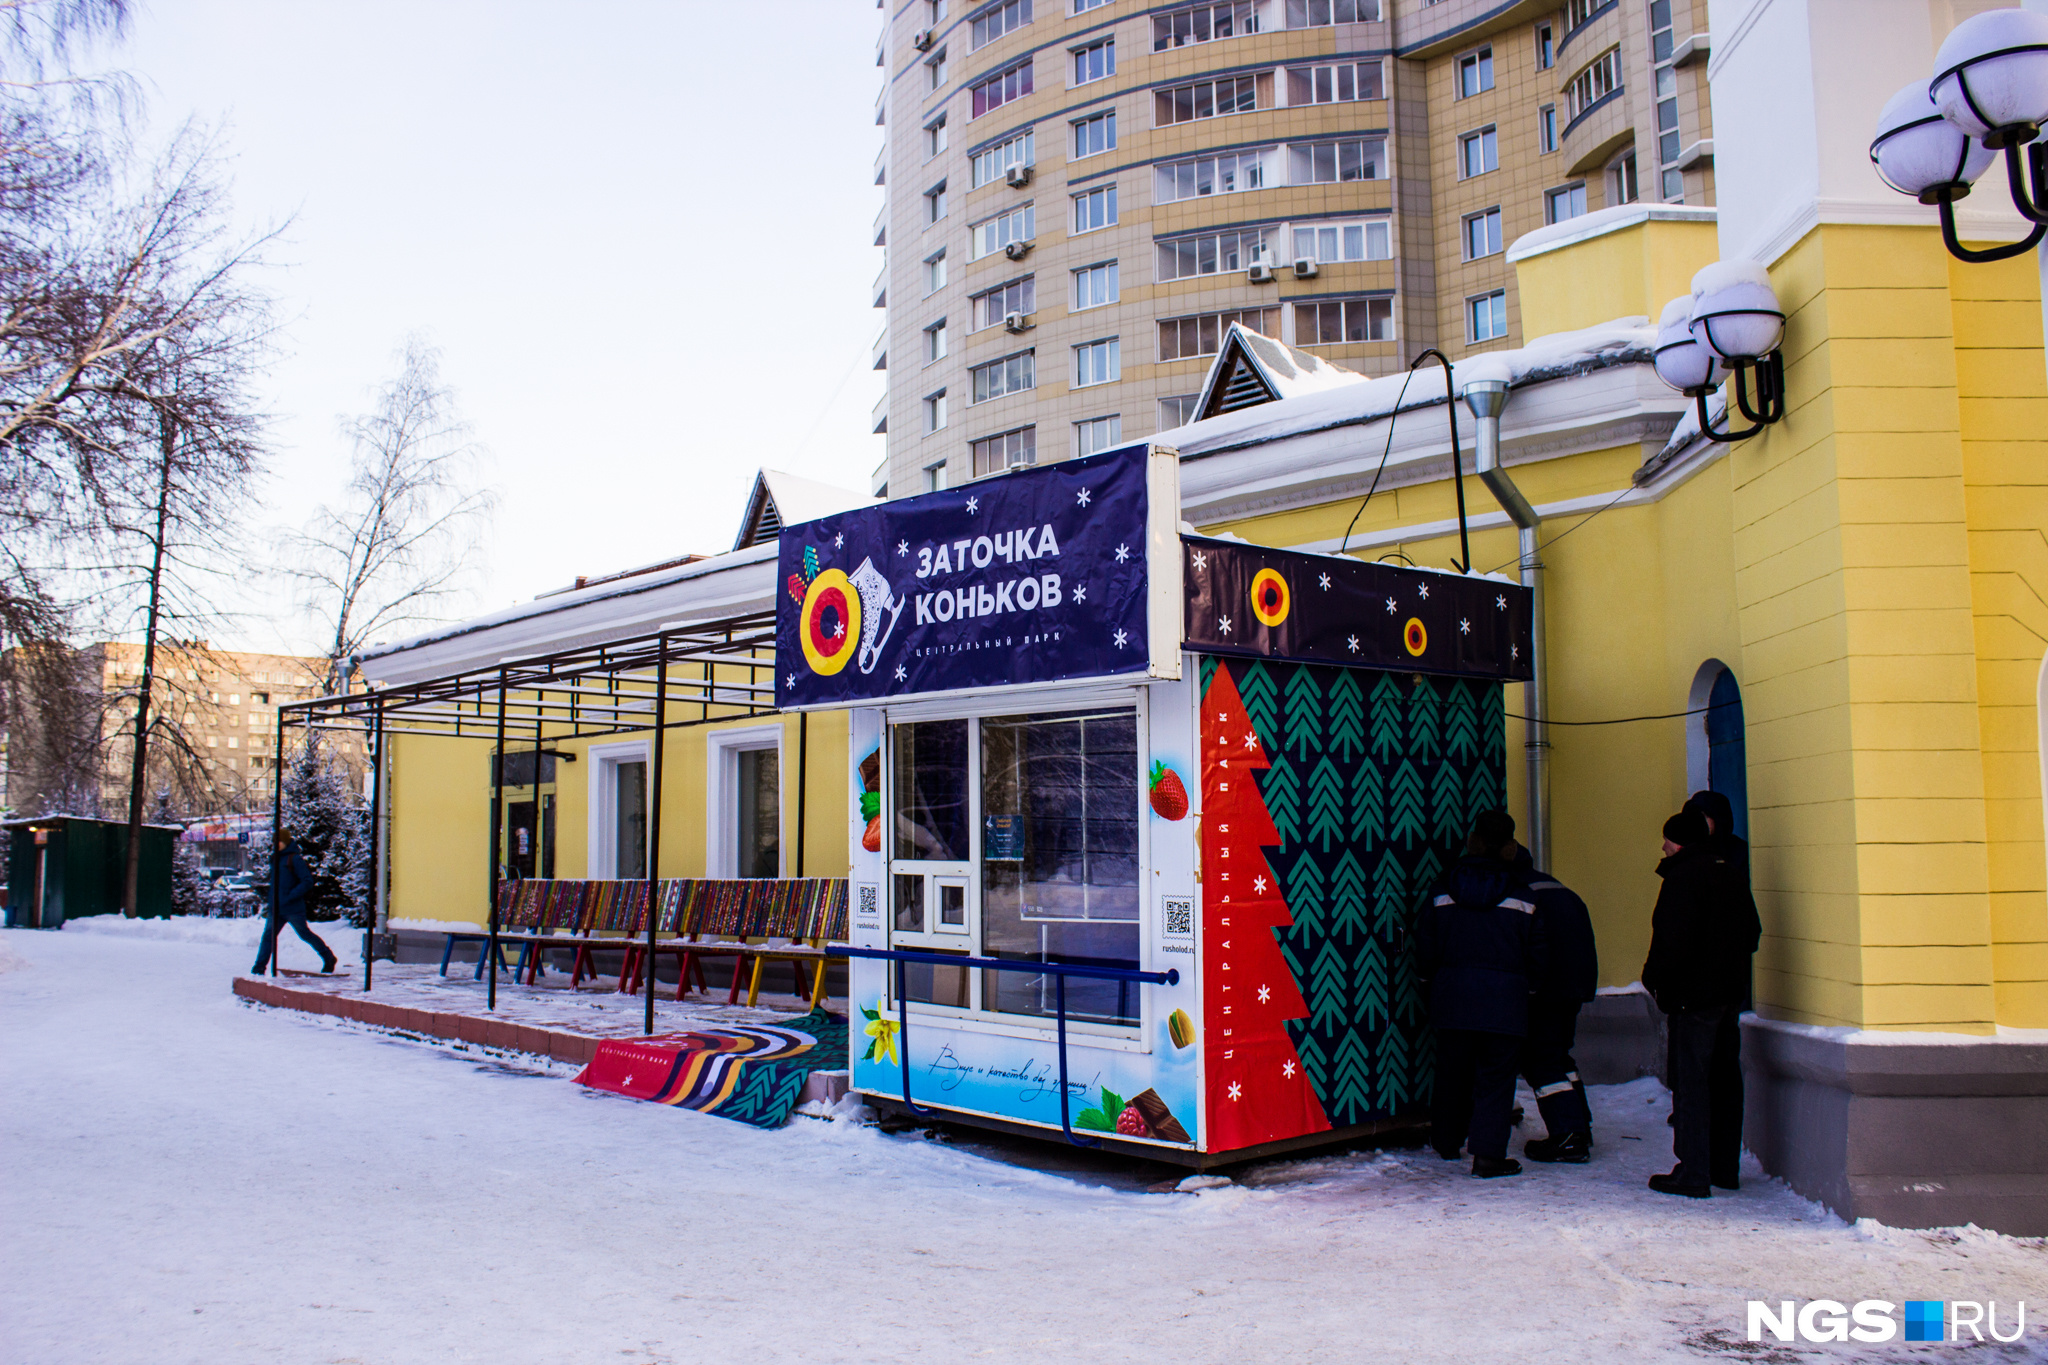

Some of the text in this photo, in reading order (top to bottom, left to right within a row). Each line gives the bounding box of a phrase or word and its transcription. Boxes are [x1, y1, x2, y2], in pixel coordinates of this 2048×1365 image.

[915, 523, 1060, 579] ЗАТОЧКА
[915, 573, 1062, 626] КОНЬКОВ
[1024, 632, 1060, 644] ПАРК
[1219, 712, 1233, 1059] ЦЕНТРАЛЬНЫЙ ПАРК
[1047, 1071, 1101, 1098] грниц!
